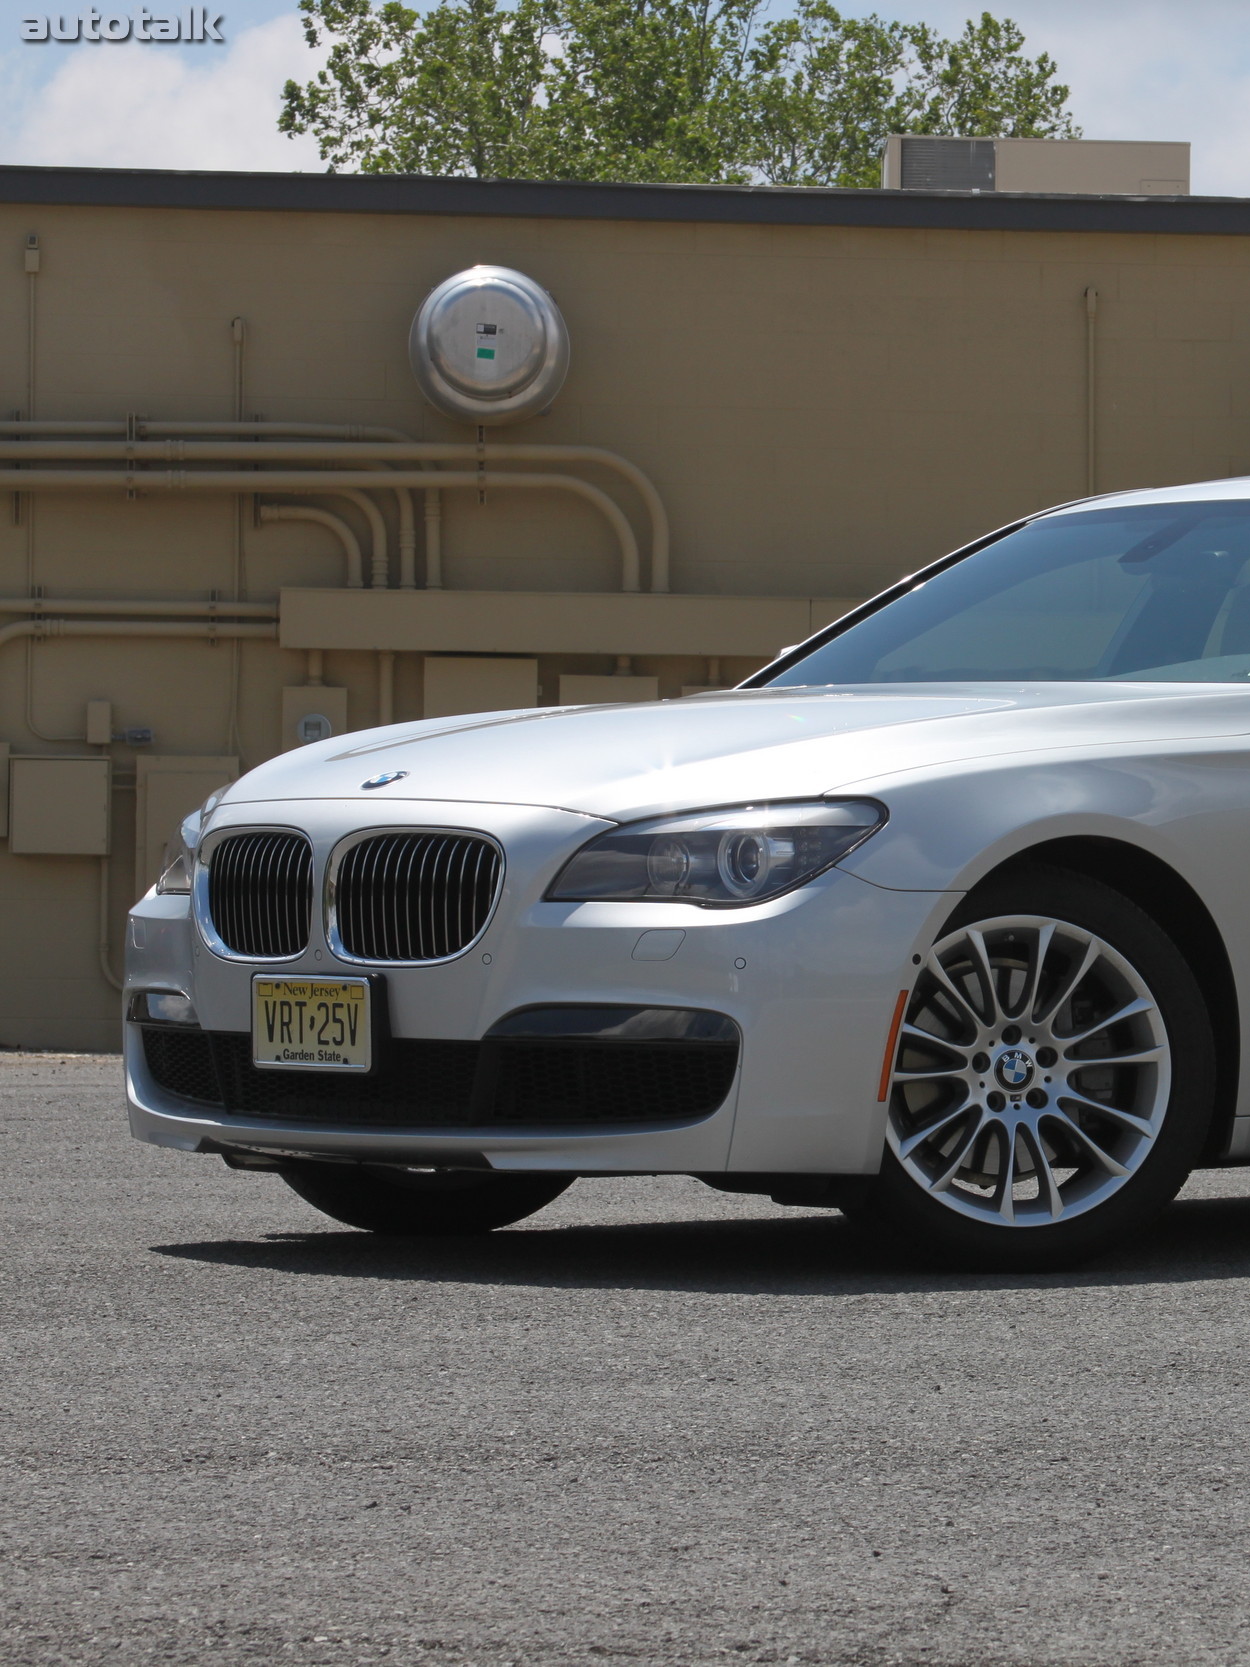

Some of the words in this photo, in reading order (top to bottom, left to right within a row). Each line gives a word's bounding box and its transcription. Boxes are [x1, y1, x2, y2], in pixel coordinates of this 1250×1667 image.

[283, 982, 308, 996] New
[309, 983, 341, 1000] Jersey
[282, 1048, 315, 1061] Garden
[317, 1050, 341, 1062] State
[1002, 1052, 1033, 1068] BMW
